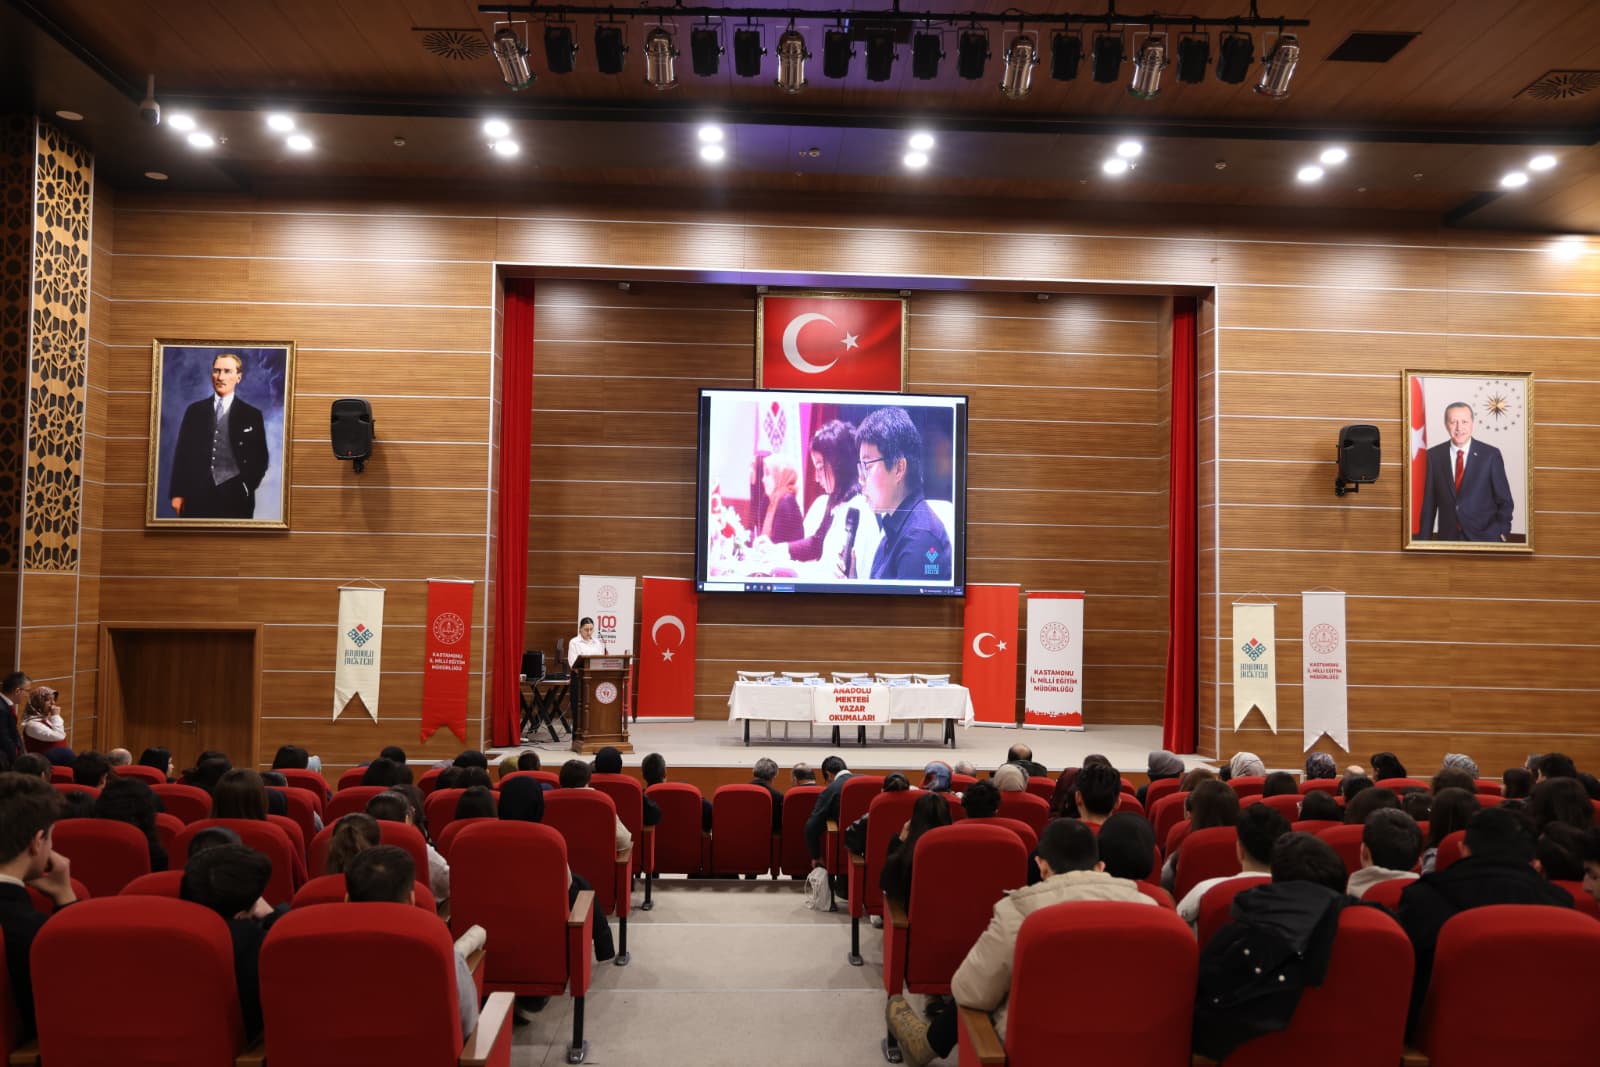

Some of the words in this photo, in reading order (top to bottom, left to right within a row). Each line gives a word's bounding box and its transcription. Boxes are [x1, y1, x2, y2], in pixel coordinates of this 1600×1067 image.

[597, 615, 617, 629] 100
[1033, 684, 1074, 692] MÜDÜRLÜĞÜ
[835, 694, 870, 703] MEKTEBİ
[839, 705, 866, 713] YAZAR
[828, 714, 876, 722] OKUMALARI
